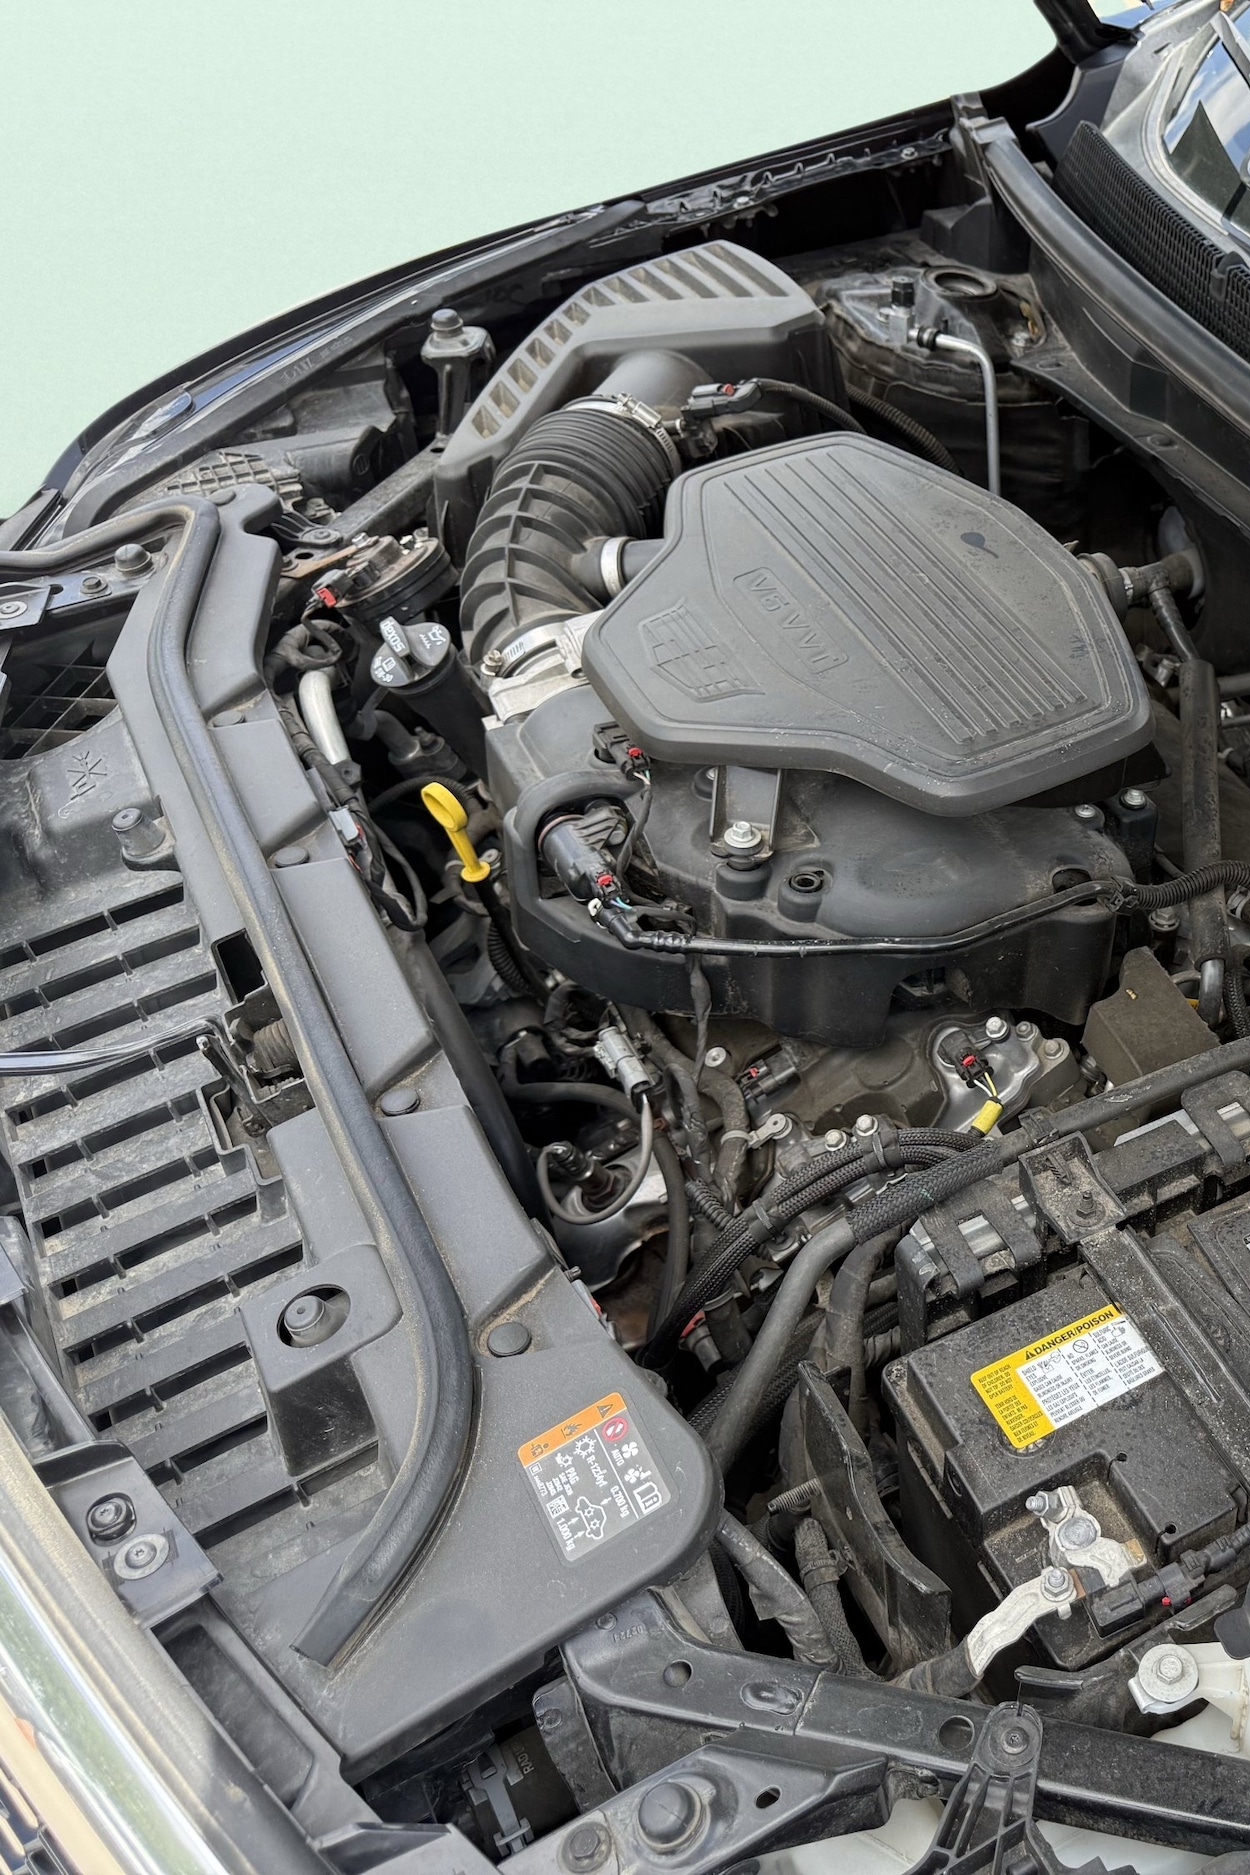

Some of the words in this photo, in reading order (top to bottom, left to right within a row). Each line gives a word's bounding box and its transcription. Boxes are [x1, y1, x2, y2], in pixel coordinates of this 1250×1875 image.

[748, 574, 791, 614] V6
[780, 610, 841, 666] VVT
[380, 620, 406, 653] dexos
[1035, 1310, 1114, 1355] DANGER/POISON
[1021, 1365, 1036, 1375] SHIELD
[1025, 1372, 1037, 1381] EYES
[988, 1391, 998, 1399] OPEN
[611, 1448, 624, 1466] AUTO
[564, 1466, 579, 1485] PAG
[586, 1455, 607, 1488] R-1234yf
[610, 1484, 625, 1507] 0.700
[617, 1504, 630, 1518] kg
[556, 1517, 572, 1541] 1.000
[563, 1537, 576, 1551] kg
[517, 1753, 535, 1775] RAD
